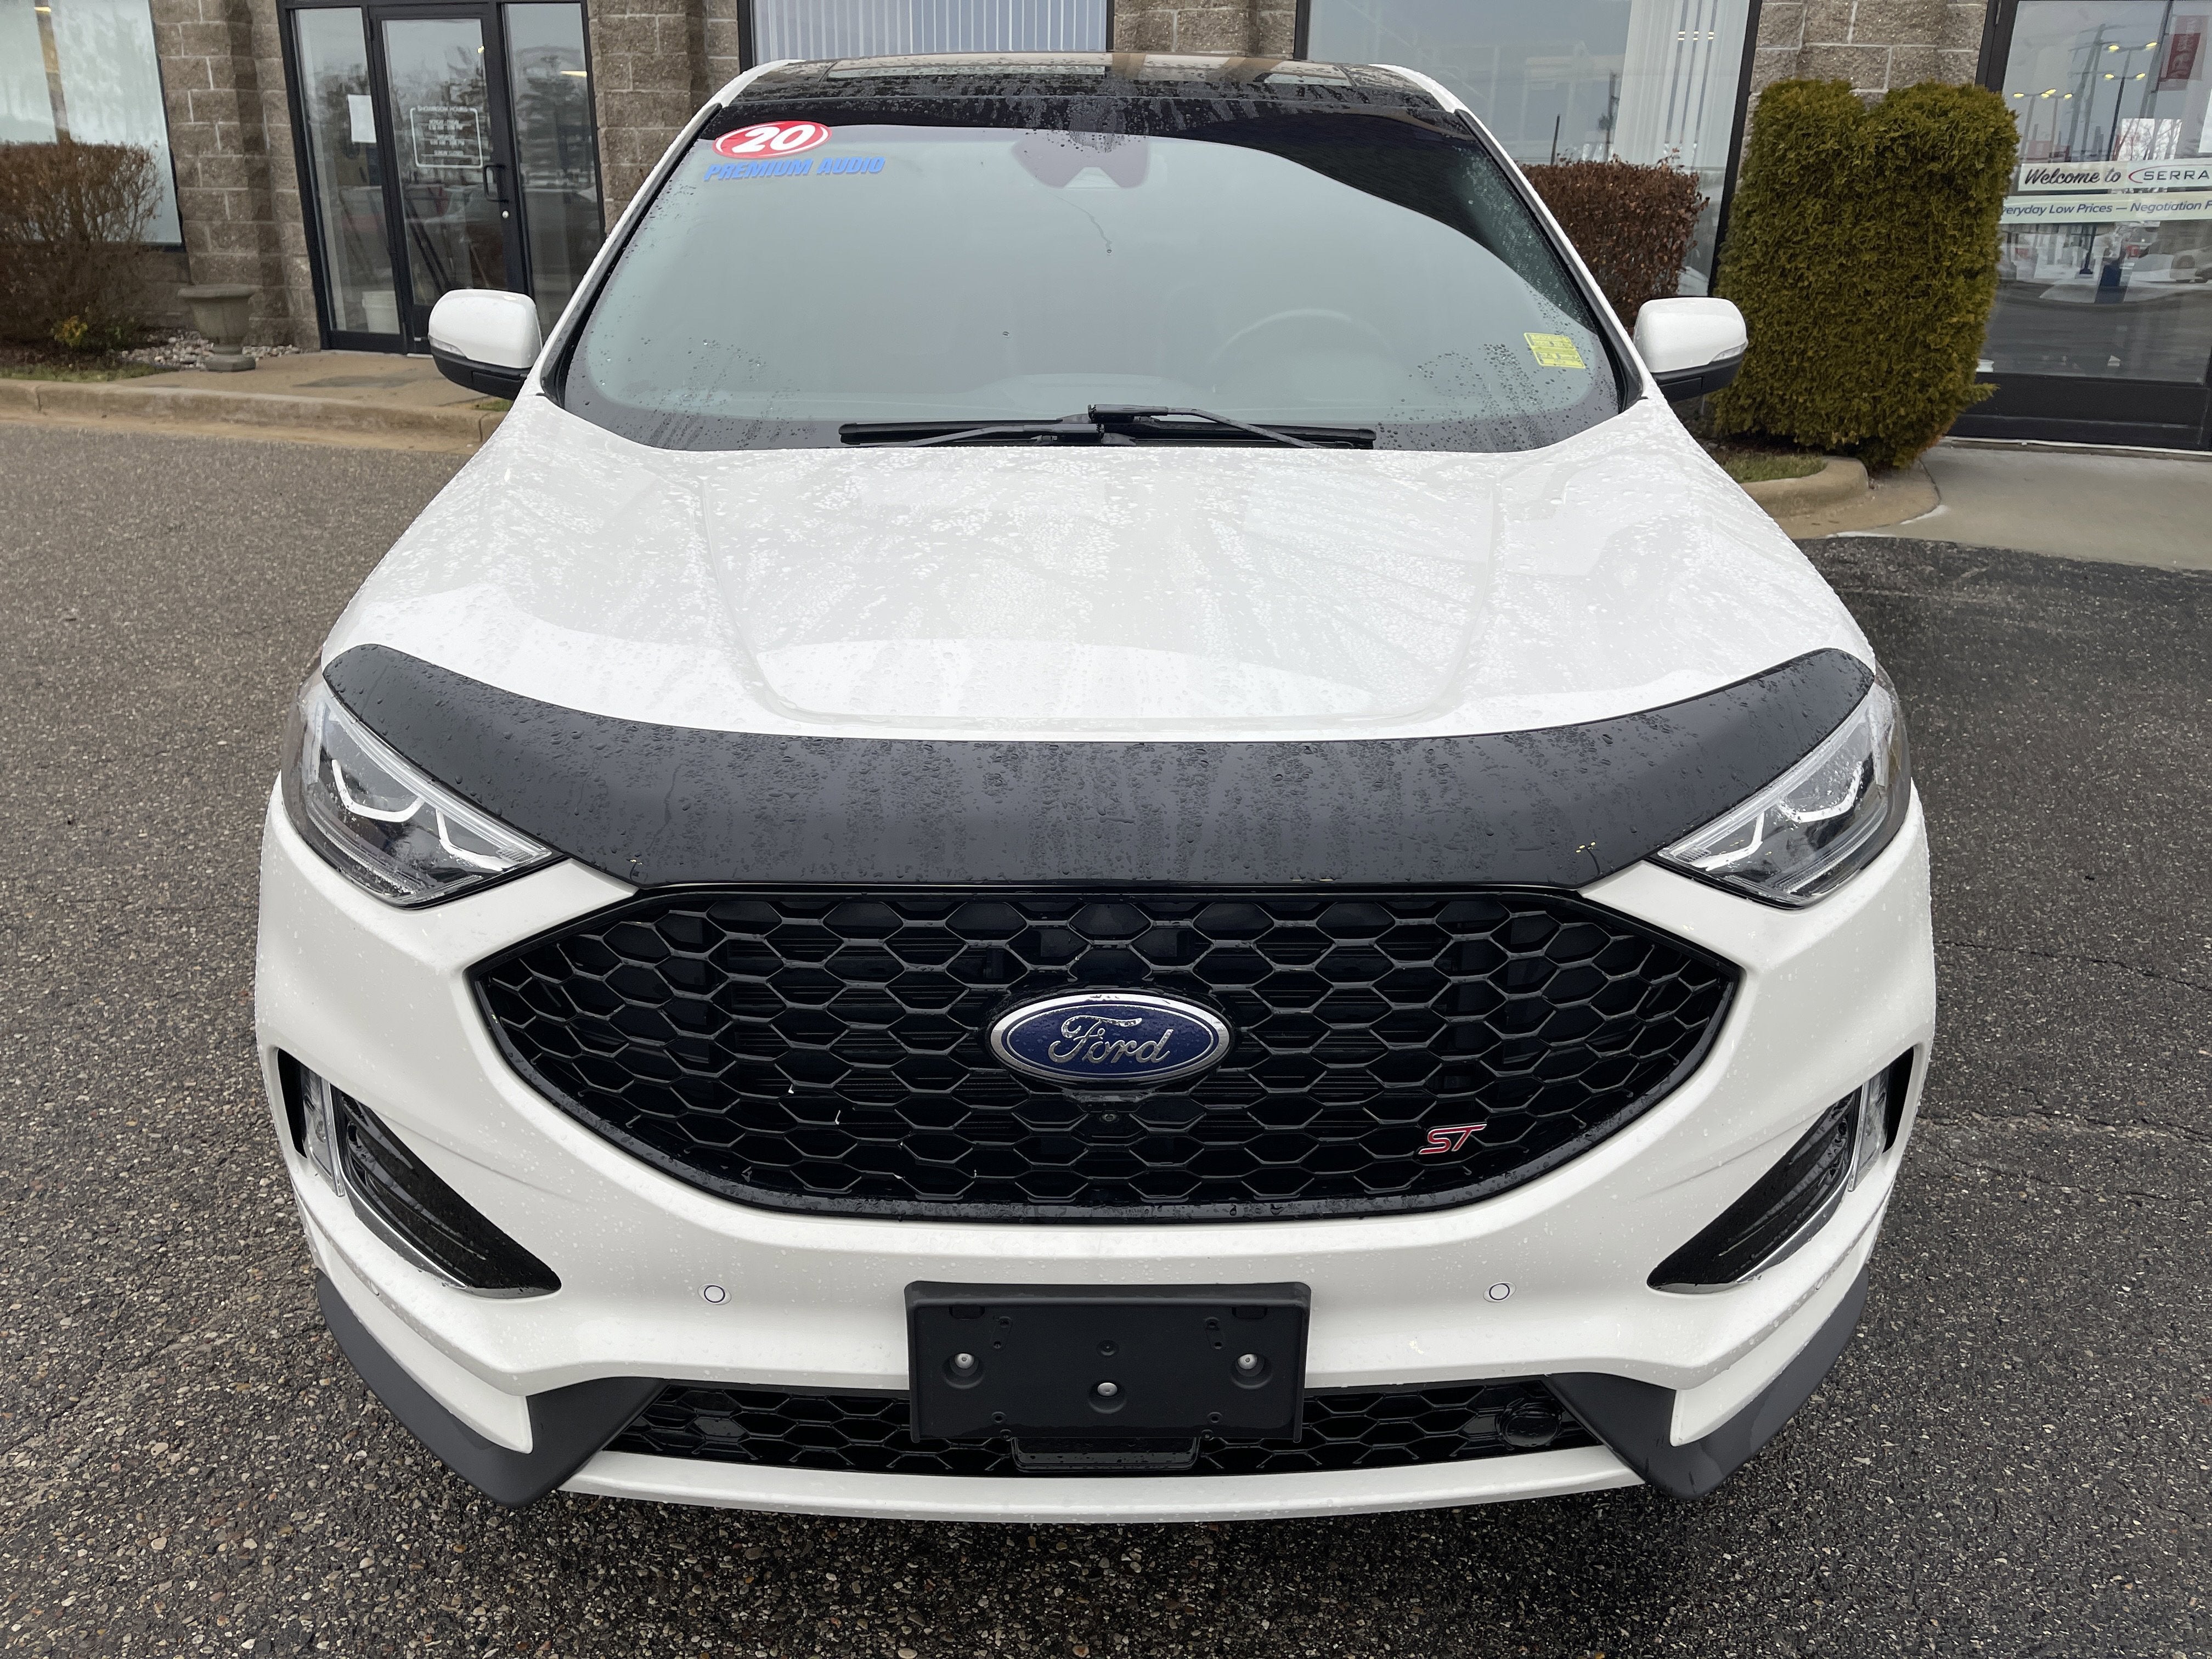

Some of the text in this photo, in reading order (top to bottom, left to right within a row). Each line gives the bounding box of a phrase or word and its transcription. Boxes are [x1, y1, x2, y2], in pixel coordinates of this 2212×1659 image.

[731, 124, 816, 153] 20
[703, 156, 885, 182] PREMIUM AUDIO
[2024, 167, 2210, 184] Welcome to SERRA
[2049, 204, 2075, 213] Low
[2076, 203, 2113, 213] Prices
[2130, 201, 2202, 213] Negotiation
[1048, 1015, 1173, 1063] Ford
[1418, 1124, 1487, 1155] ST
